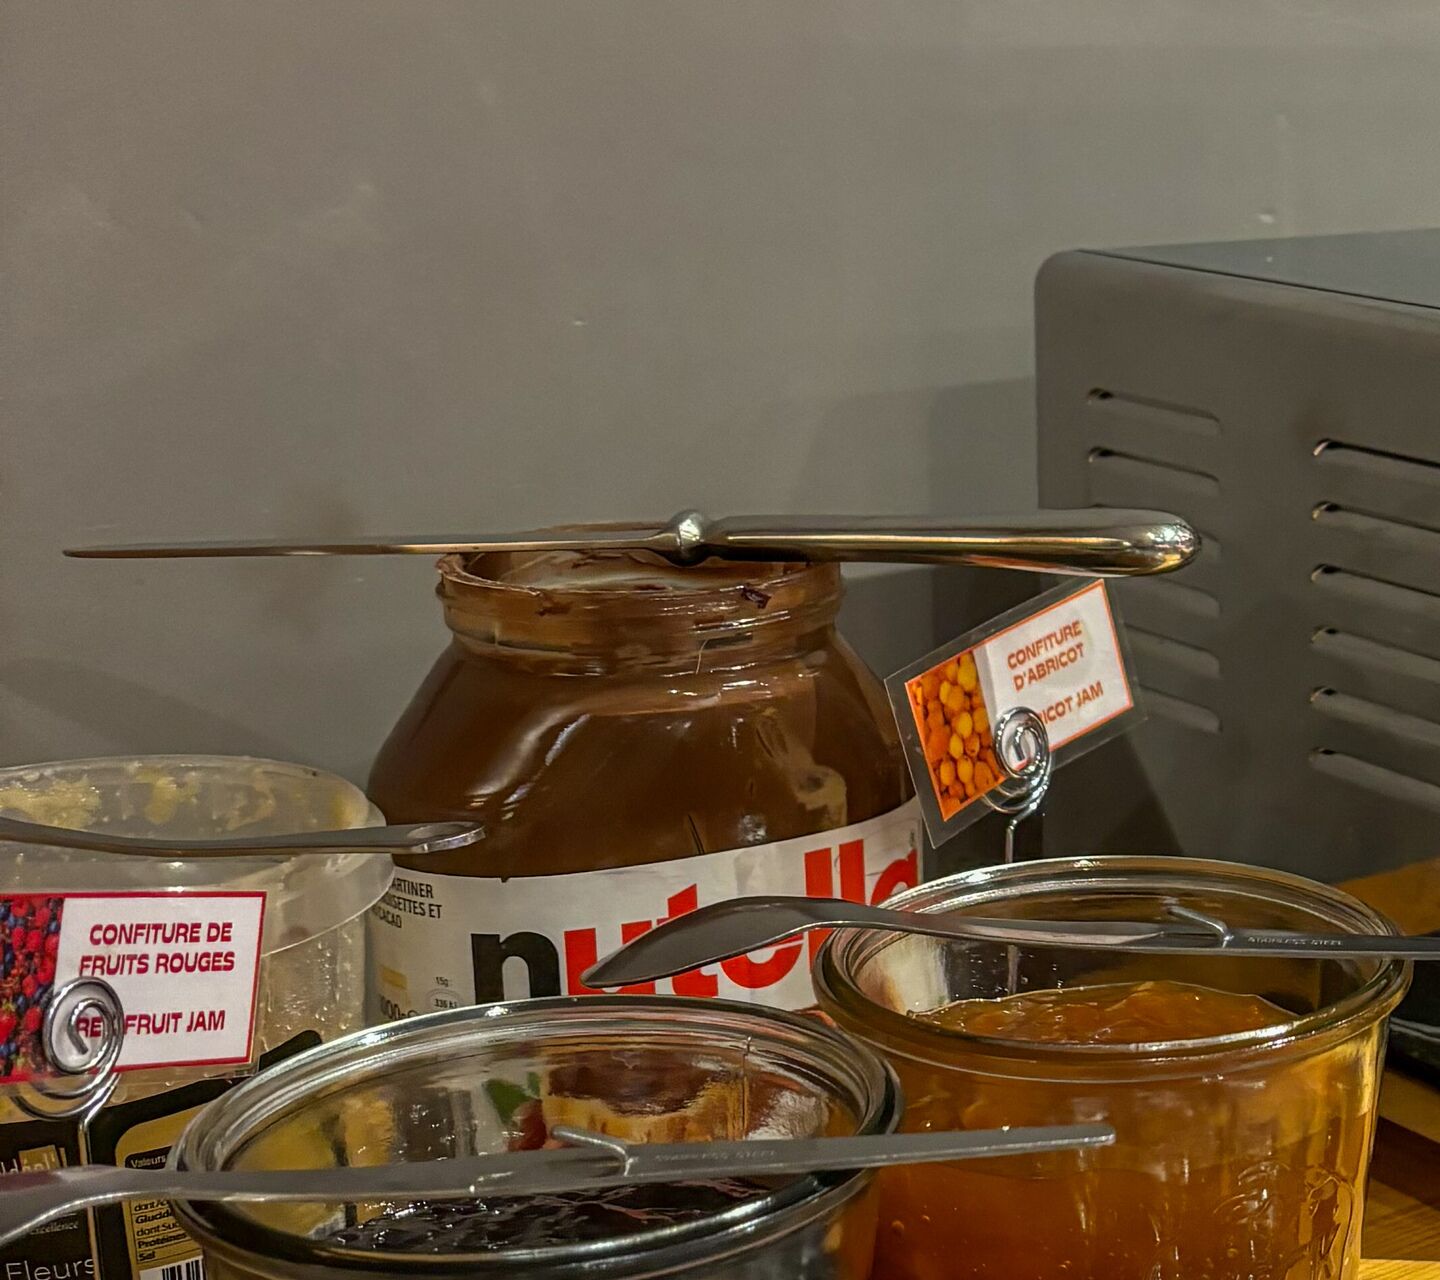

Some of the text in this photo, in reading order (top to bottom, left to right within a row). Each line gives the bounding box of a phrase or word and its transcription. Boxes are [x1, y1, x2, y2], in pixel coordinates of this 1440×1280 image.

[1007, 620, 1082, 670] CONFITURE
[1013, 642, 1084, 692] D'ABRICOT
[1041, 680, 1104, 725] ICOT JAM
[391, 878, 434, 899] ARTINER
[429, 904, 442, 918] ET
[89, 922, 233, 946] CONFITURE DE
[80, 951, 235, 976] FRUITS ROUGES
[75, 1010, 226, 1037] RE FRUIT JAM
[136, 1209, 171, 1224] Glucid
